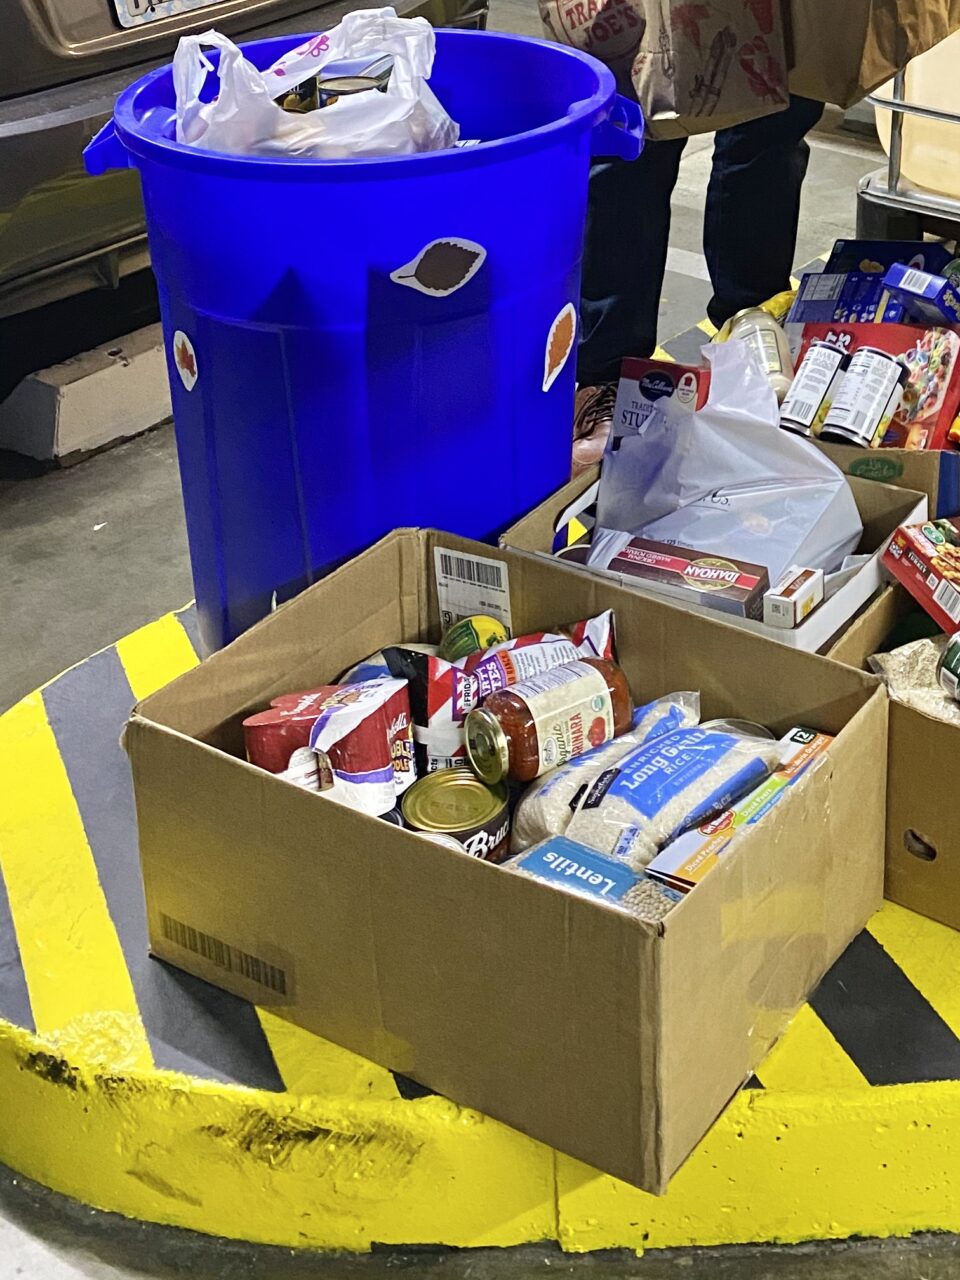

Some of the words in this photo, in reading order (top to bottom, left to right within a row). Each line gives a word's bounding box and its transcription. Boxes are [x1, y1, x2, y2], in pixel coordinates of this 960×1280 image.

[583, 5, 639, 51] JOE'S
[682, 564, 741, 587] IDAHOAN
[907, 550, 928, 574] TURKEY
[485, 661, 502, 692] TES
[391, 739, 412, 761] UBLE
[551, 723, 571, 767] Organic
[570, 712, 584, 757] ARINARA
[794, 730, 809, 743] 12
[622, 734, 681, 774] ENRICHED
[663, 751, 692, 775] RICE
[619, 755, 670, 790] Long
[463, 820, 511, 858] Bruc
[685, 854, 703, 872] Diced
[701, 835, 725, 858] Peaches
[541, 849, 617, 896] Lentils
